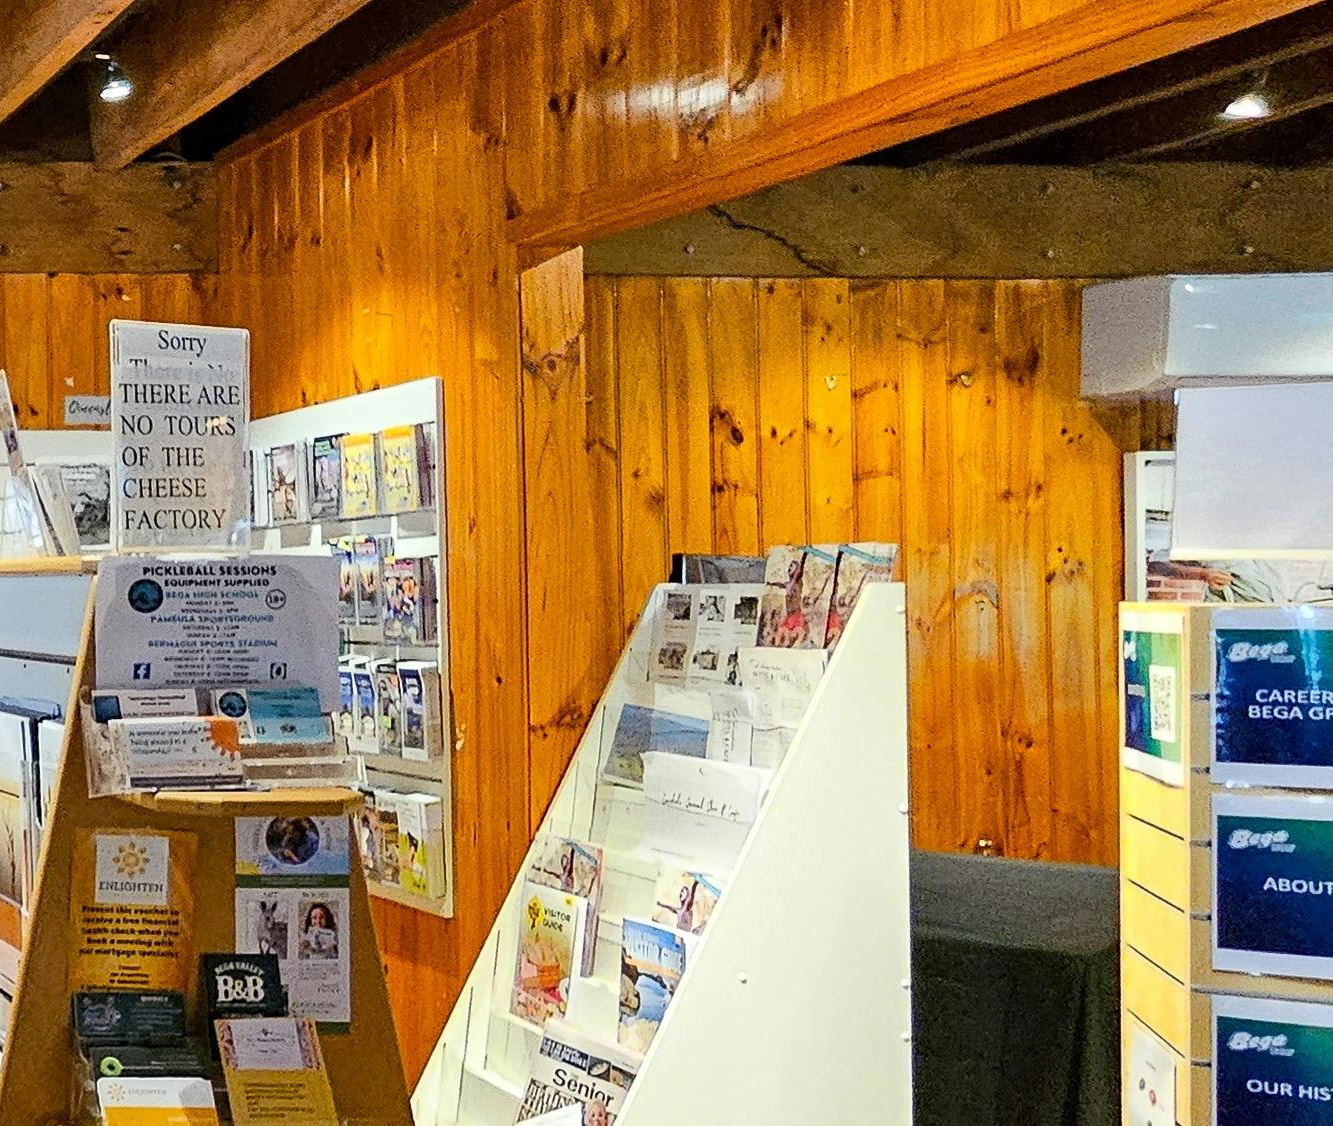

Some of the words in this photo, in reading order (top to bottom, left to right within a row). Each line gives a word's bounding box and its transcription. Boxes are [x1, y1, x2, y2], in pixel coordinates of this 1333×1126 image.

[158, 330, 207, 357] Sorry
[119, 383, 191, 404] THERE
[197, 385, 240, 405] ARE
[121, 415, 153, 435] NO
[164, 415, 236, 436] TOURS
[122, 446, 150, 467] OF
[161, 447, 205, 467] THE
[123, 478, 207, 499] CHEESE
[124, 509, 226, 530] FACTORY
[142, 566, 215, 577] PICKLEBALL
[219, 565, 277, 577] SESSIONS
[1248, 705, 1303, 720] BEGA
[99, 880, 164, 893] ENLIGHTEN
[1264, 876, 1333, 894] ABOUT
[216, 974, 265, 1003] B&B
[552, 1068, 616, 1112] Senior
[1246, 1078, 1293, 1097] OUR
